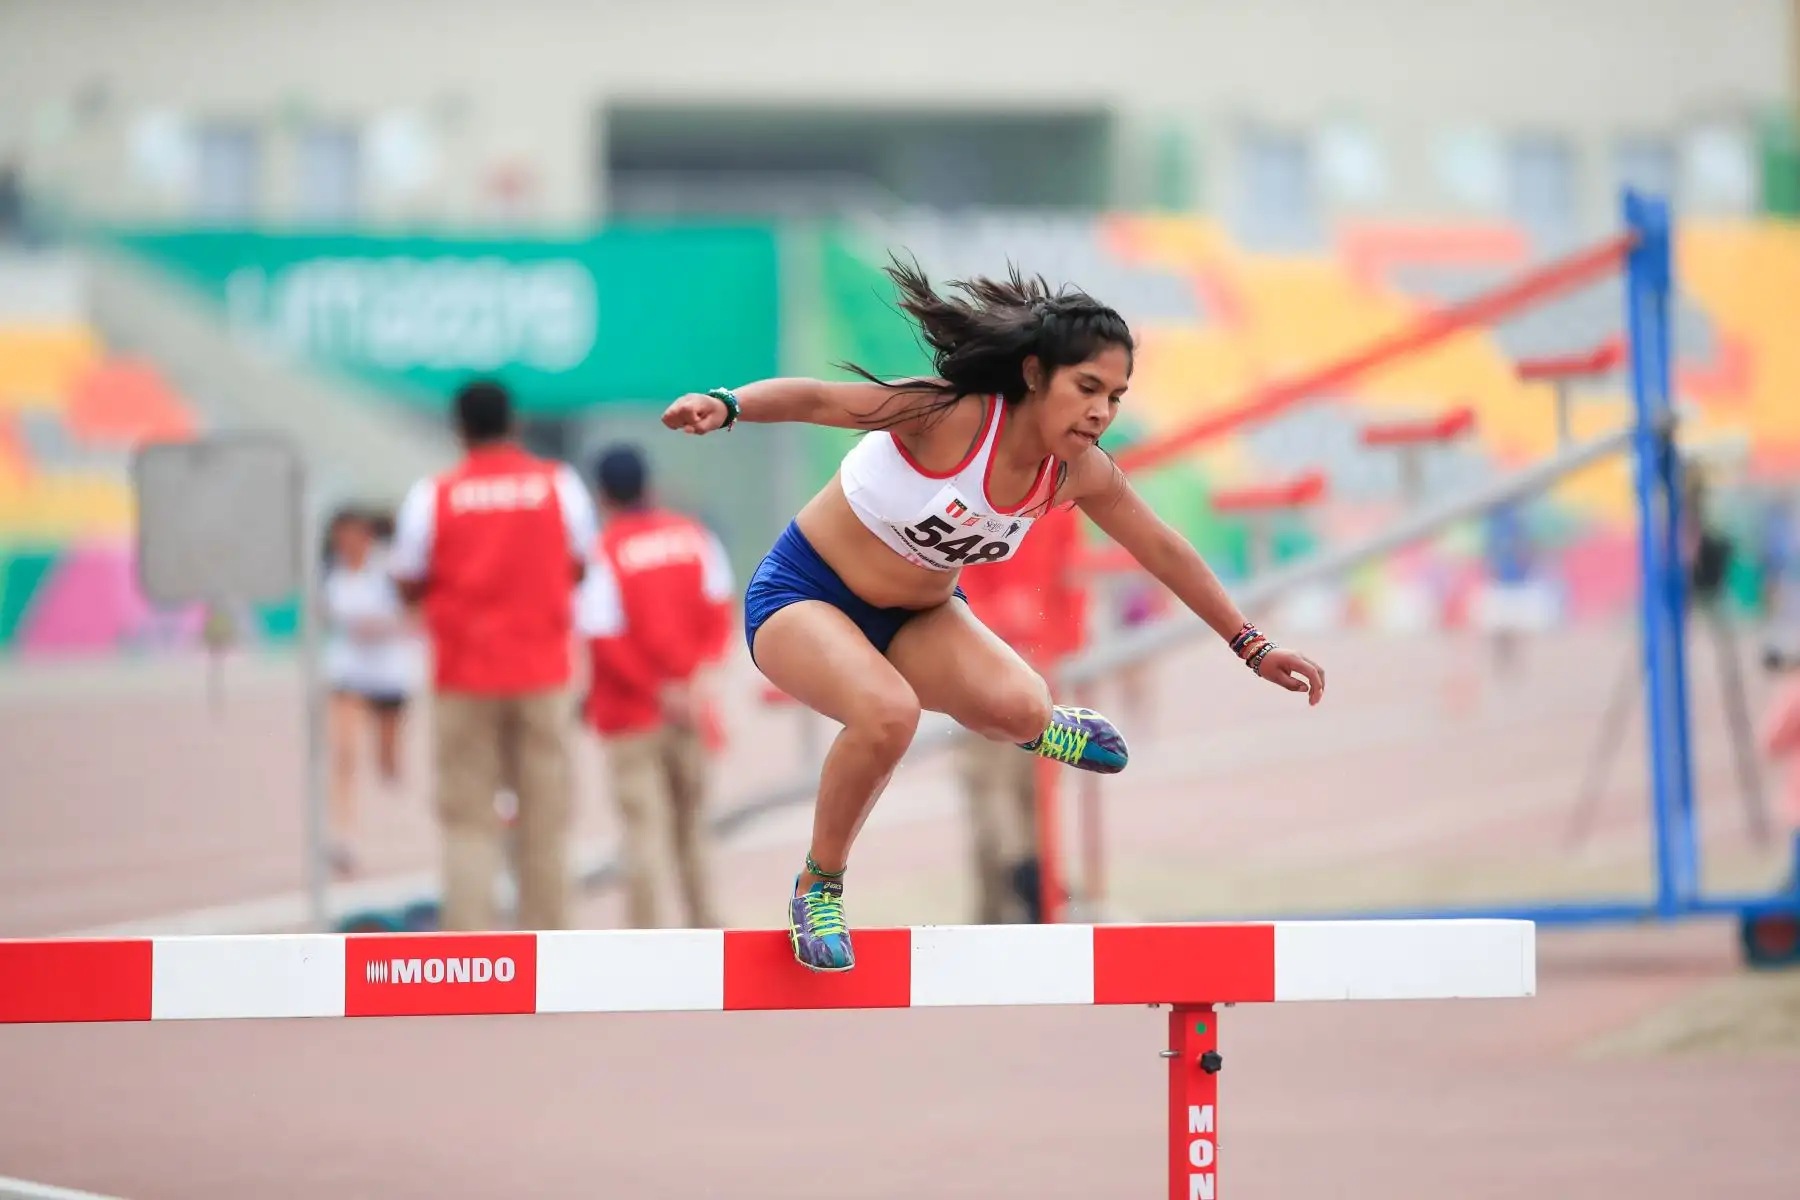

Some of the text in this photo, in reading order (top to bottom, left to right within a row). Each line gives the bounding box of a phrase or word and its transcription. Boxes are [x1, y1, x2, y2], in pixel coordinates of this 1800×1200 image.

[905, 515, 1009, 565] 548
[391, 957, 515, 983] MONDO
[1188, 1105, 1214, 1200] MON
